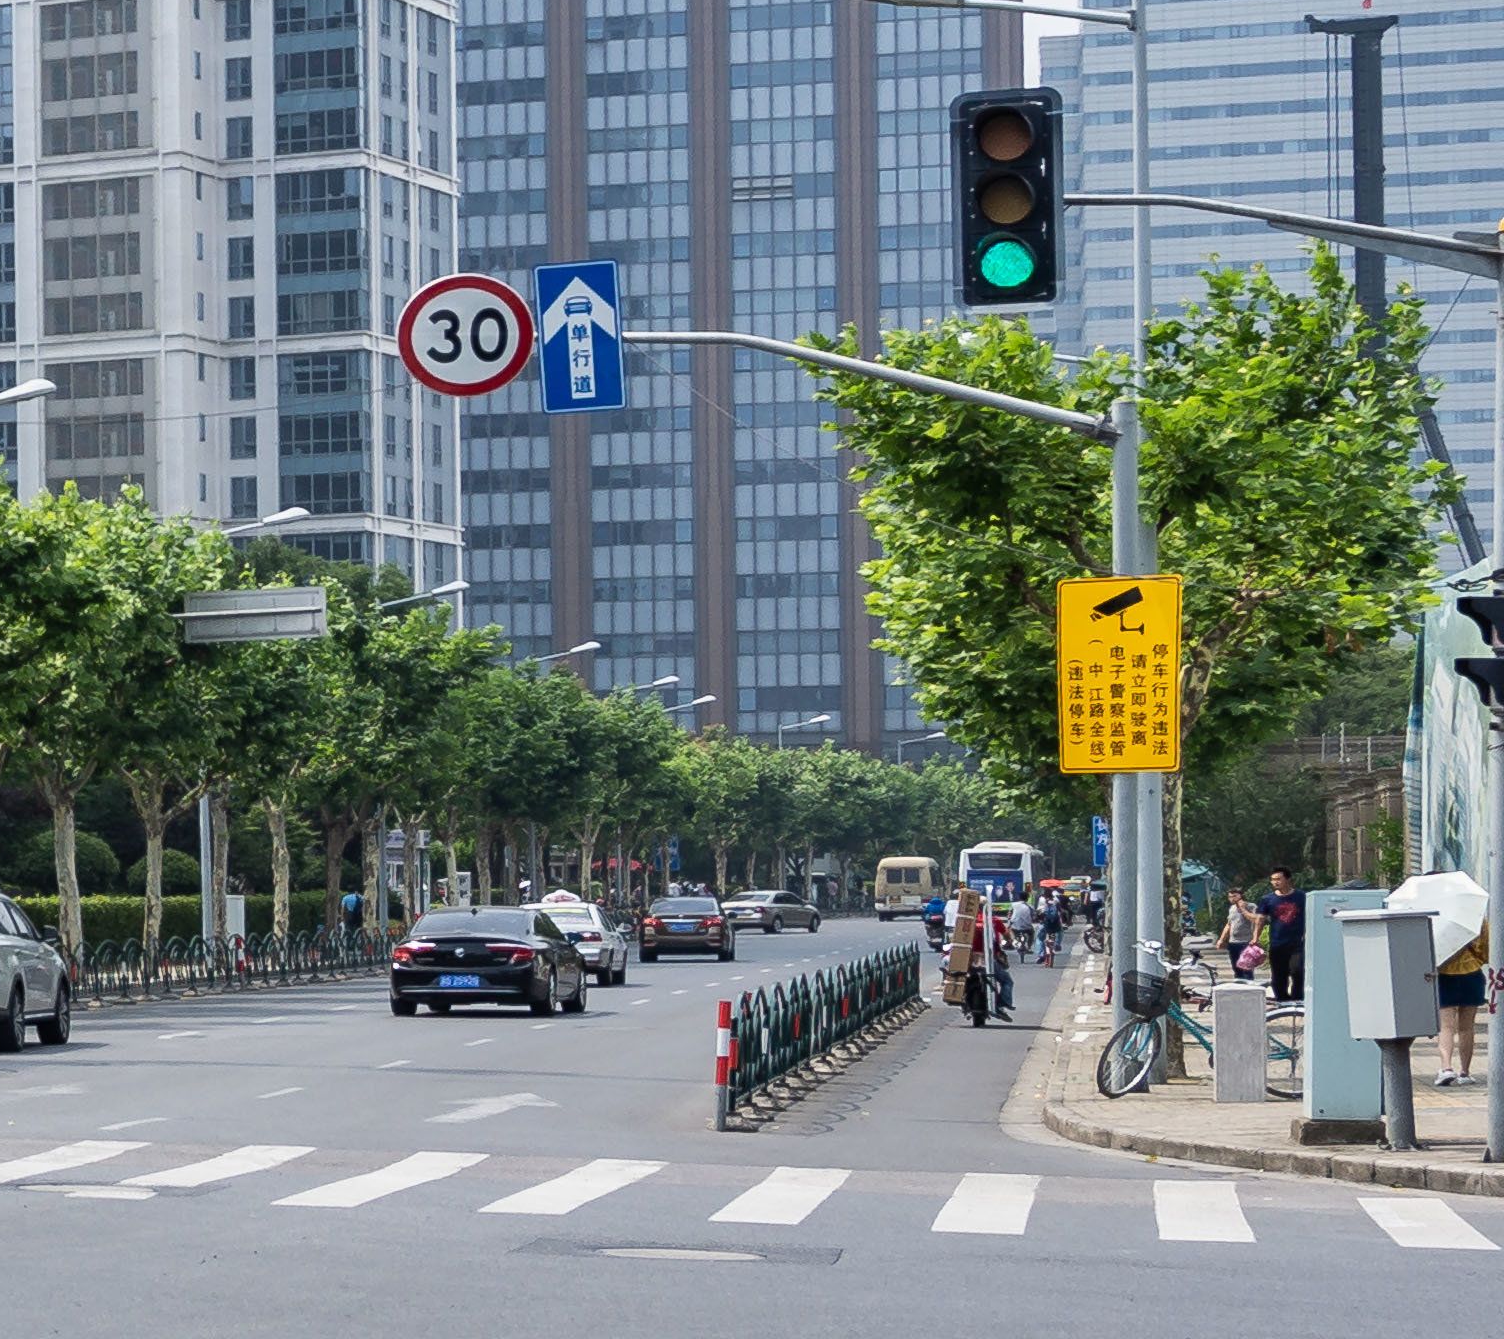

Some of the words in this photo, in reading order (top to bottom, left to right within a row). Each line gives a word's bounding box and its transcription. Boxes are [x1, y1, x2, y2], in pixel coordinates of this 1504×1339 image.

[426, 307, 509, 364] 30
[570, 323, 593, 394] 单行道
